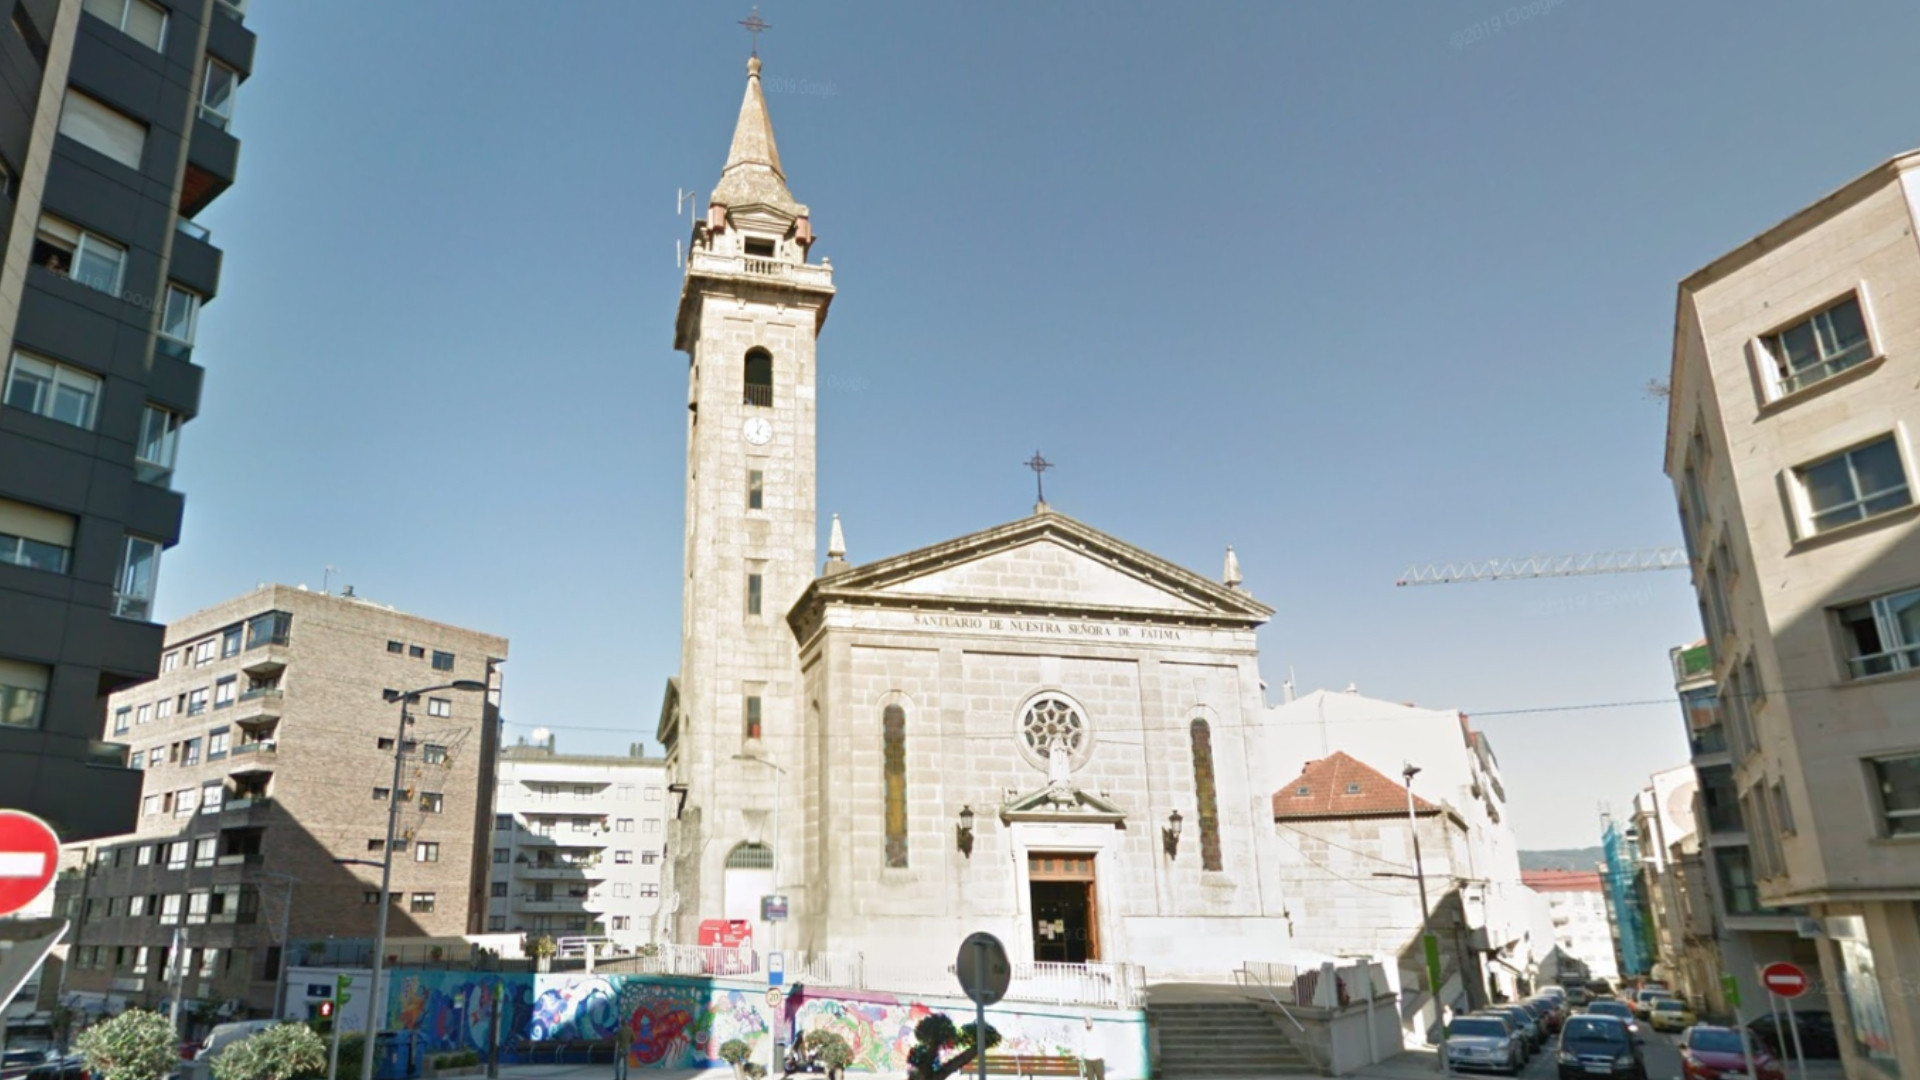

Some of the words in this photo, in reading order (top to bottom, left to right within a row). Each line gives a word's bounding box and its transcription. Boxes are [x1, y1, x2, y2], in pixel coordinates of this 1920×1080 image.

[913, 615, 982, 629] SANTUARIO
[989, 619, 1004, 630] DE
[1010, 619, 1061, 633] NUESTRA
[1118, 627, 1131, 637] DE
